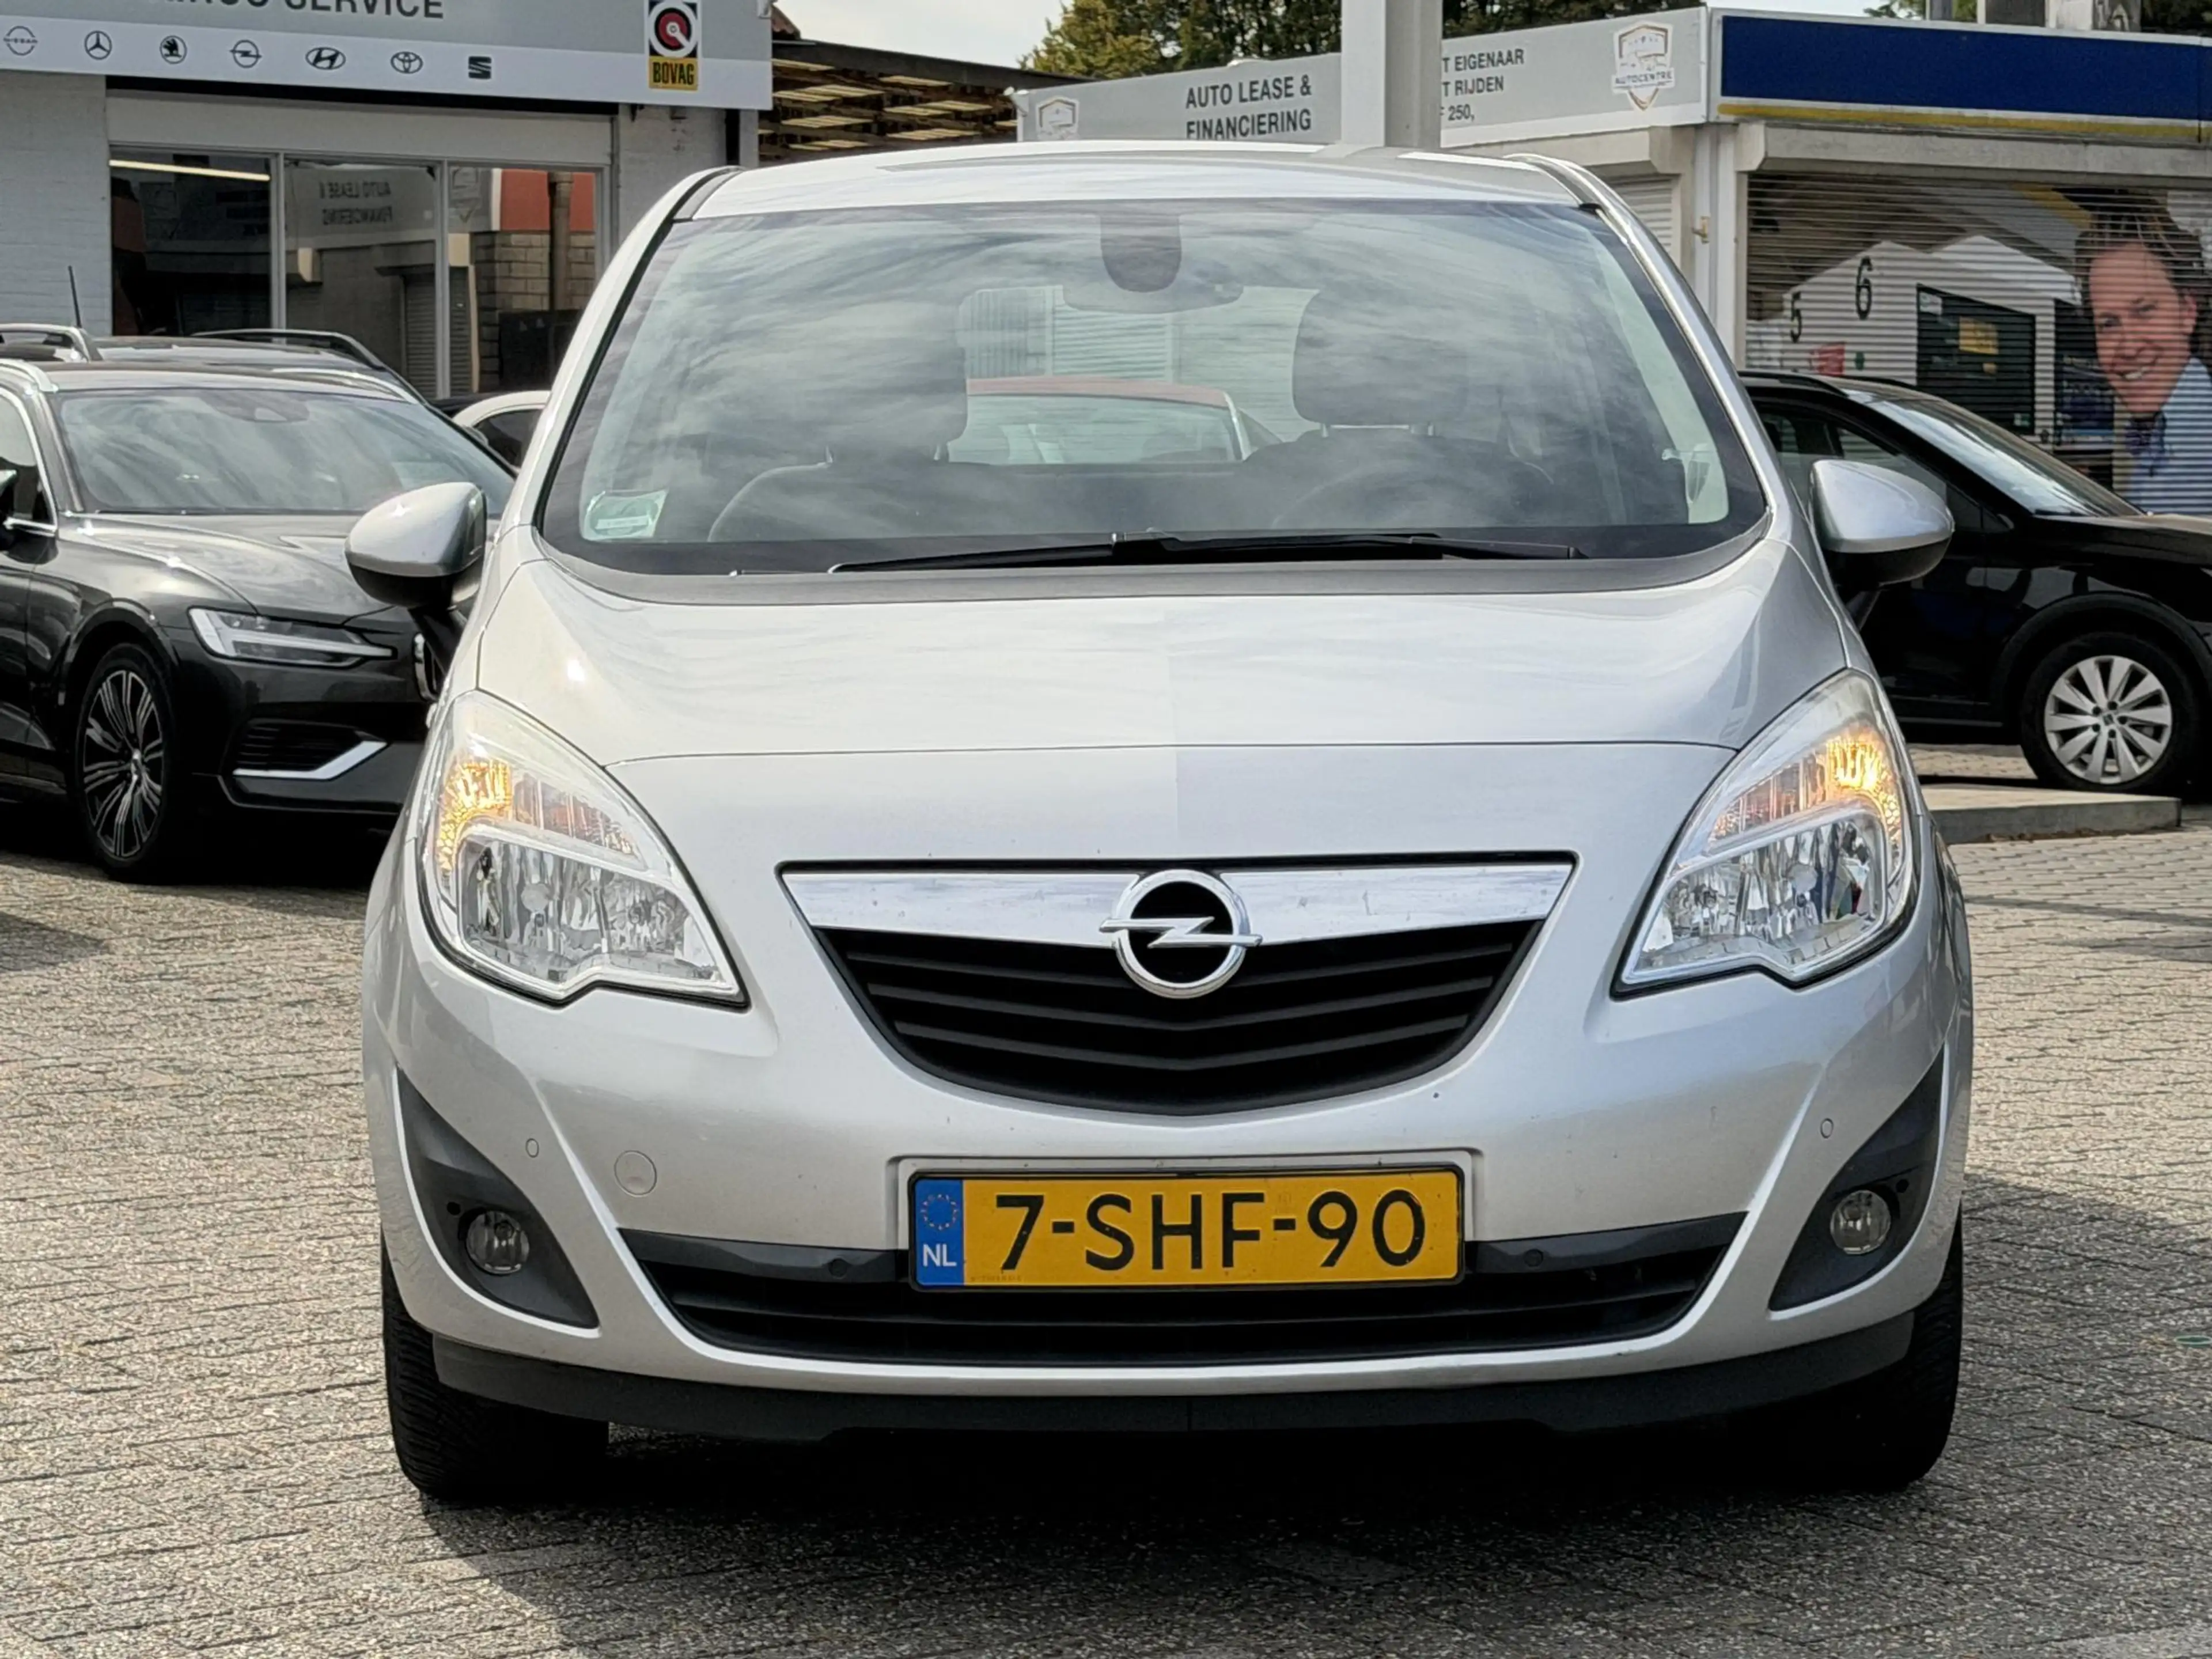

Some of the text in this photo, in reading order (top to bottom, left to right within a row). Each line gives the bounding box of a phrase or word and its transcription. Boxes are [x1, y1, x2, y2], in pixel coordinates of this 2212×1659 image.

[653, 61, 695, 85] BOVAG
[1455, 48, 1524, 71] EIGENAAR
[1185, 74, 1312, 109] AUTO LEASE &
[1455, 75, 1503, 96] RIJDEN
[1186, 108, 1312, 141] FINANCIERING
[1855, 256, 1873, 320] 6
[1790, 291, 1802, 343] 5
[995, 1189, 1426, 1271] 7-SHF-90
[923, 1243, 957, 1267] NL
